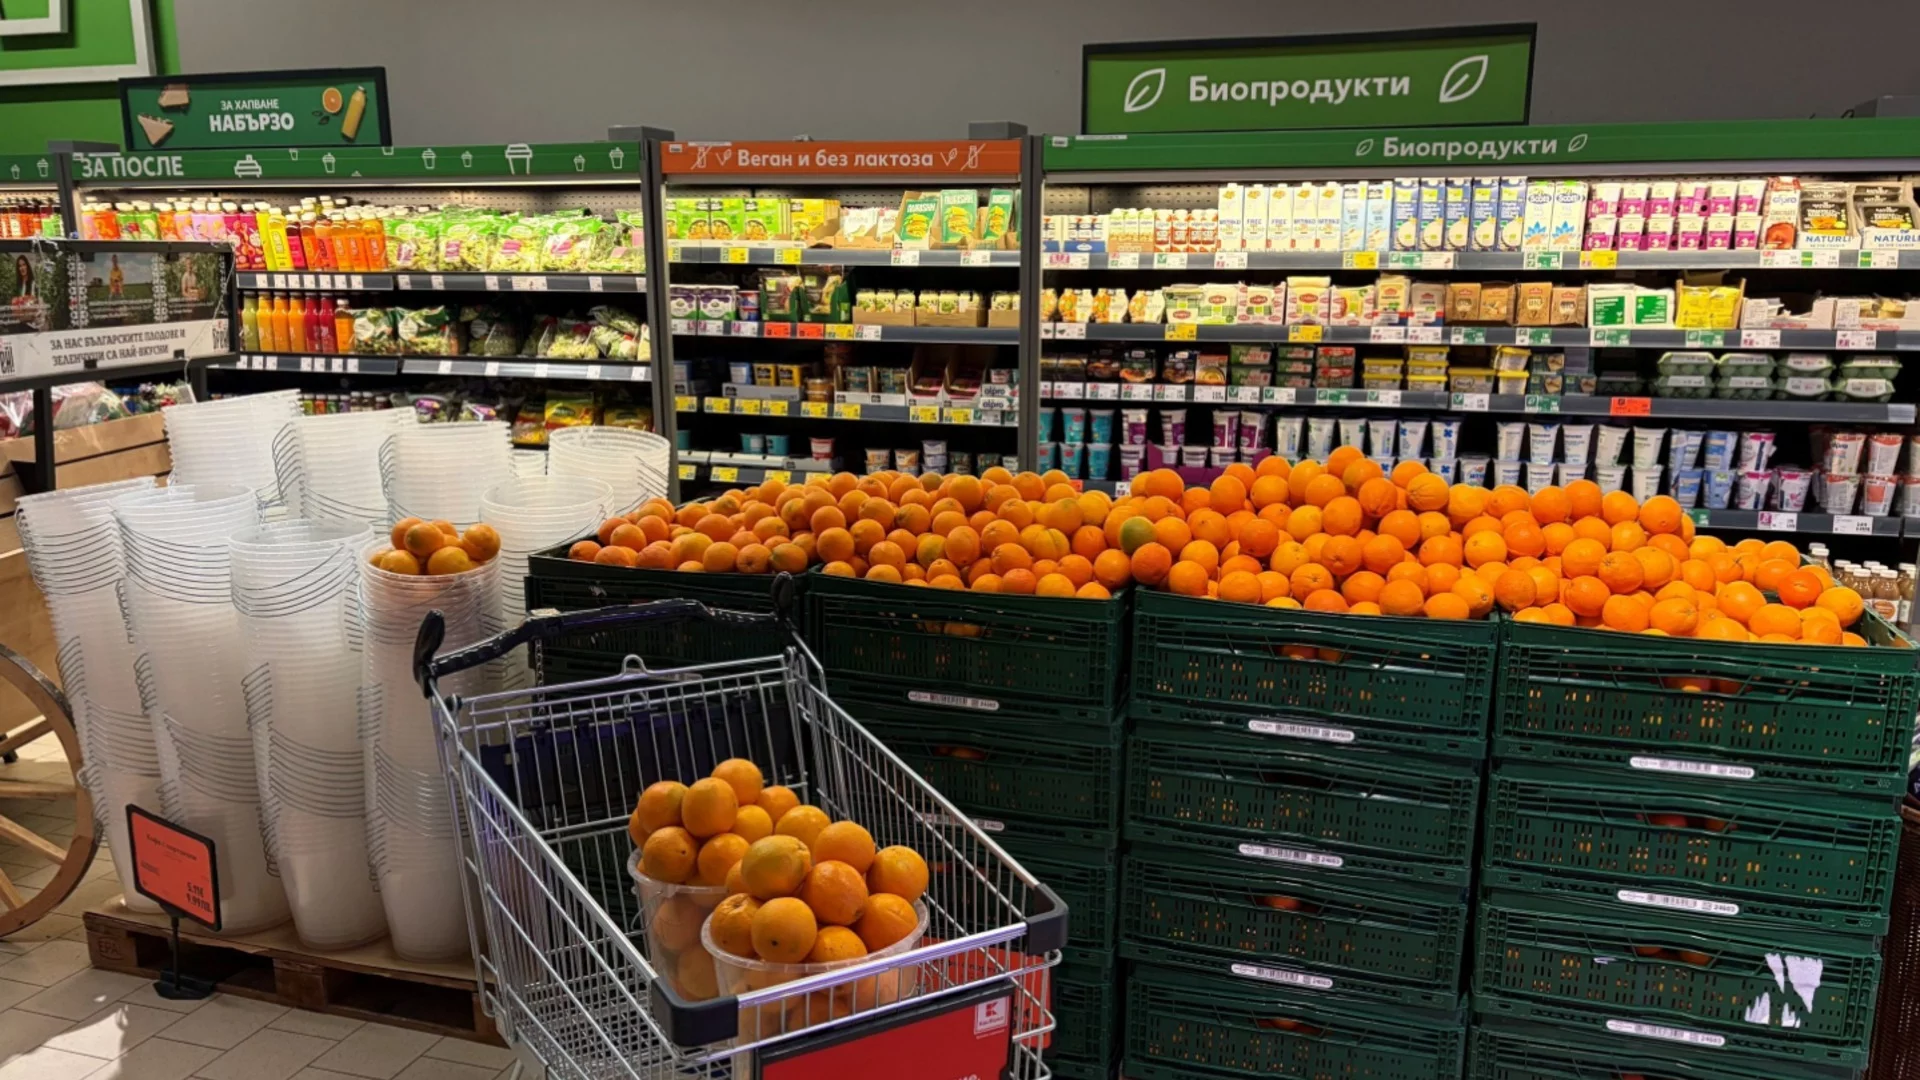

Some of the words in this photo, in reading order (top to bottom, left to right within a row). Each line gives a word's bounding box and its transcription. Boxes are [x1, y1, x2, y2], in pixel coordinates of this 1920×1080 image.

[1189, 74, 1410, 106] Биопродукти
[221, 100, 233, 111] ЗА
[235, 98, 279, 110] ХАПВАНЕ
[209, 112, 294, 132] НАБЪРЗО
[1383, 136, 1558, 160] Биопродукти
[81, 157, 108, 177] ЗА
[112, 155, 184, 177] ПОСЛЕ
[738, 149, 793, 167] Веган
[799, 153, 810, 166] и
[815, 149, 848, 167] без
[854, 152, 934, 167] лактоза
[50, 339, 63, 350] ЗА
[64, 336, 83, 349] НАС
[84, 332, 143, 348] БЪЛГАРСКИТЕ
[144, 329, 179, 342] ПЛОДОВЕ
[179, 328, 186, 338] И
[106, 349, 118, 361] СА
[119, 344, 169, 359] НАЙ-ВКУСНИ
[984, 386, 1006, 396] alpro
[983, 399, 1004, 409] alpro
